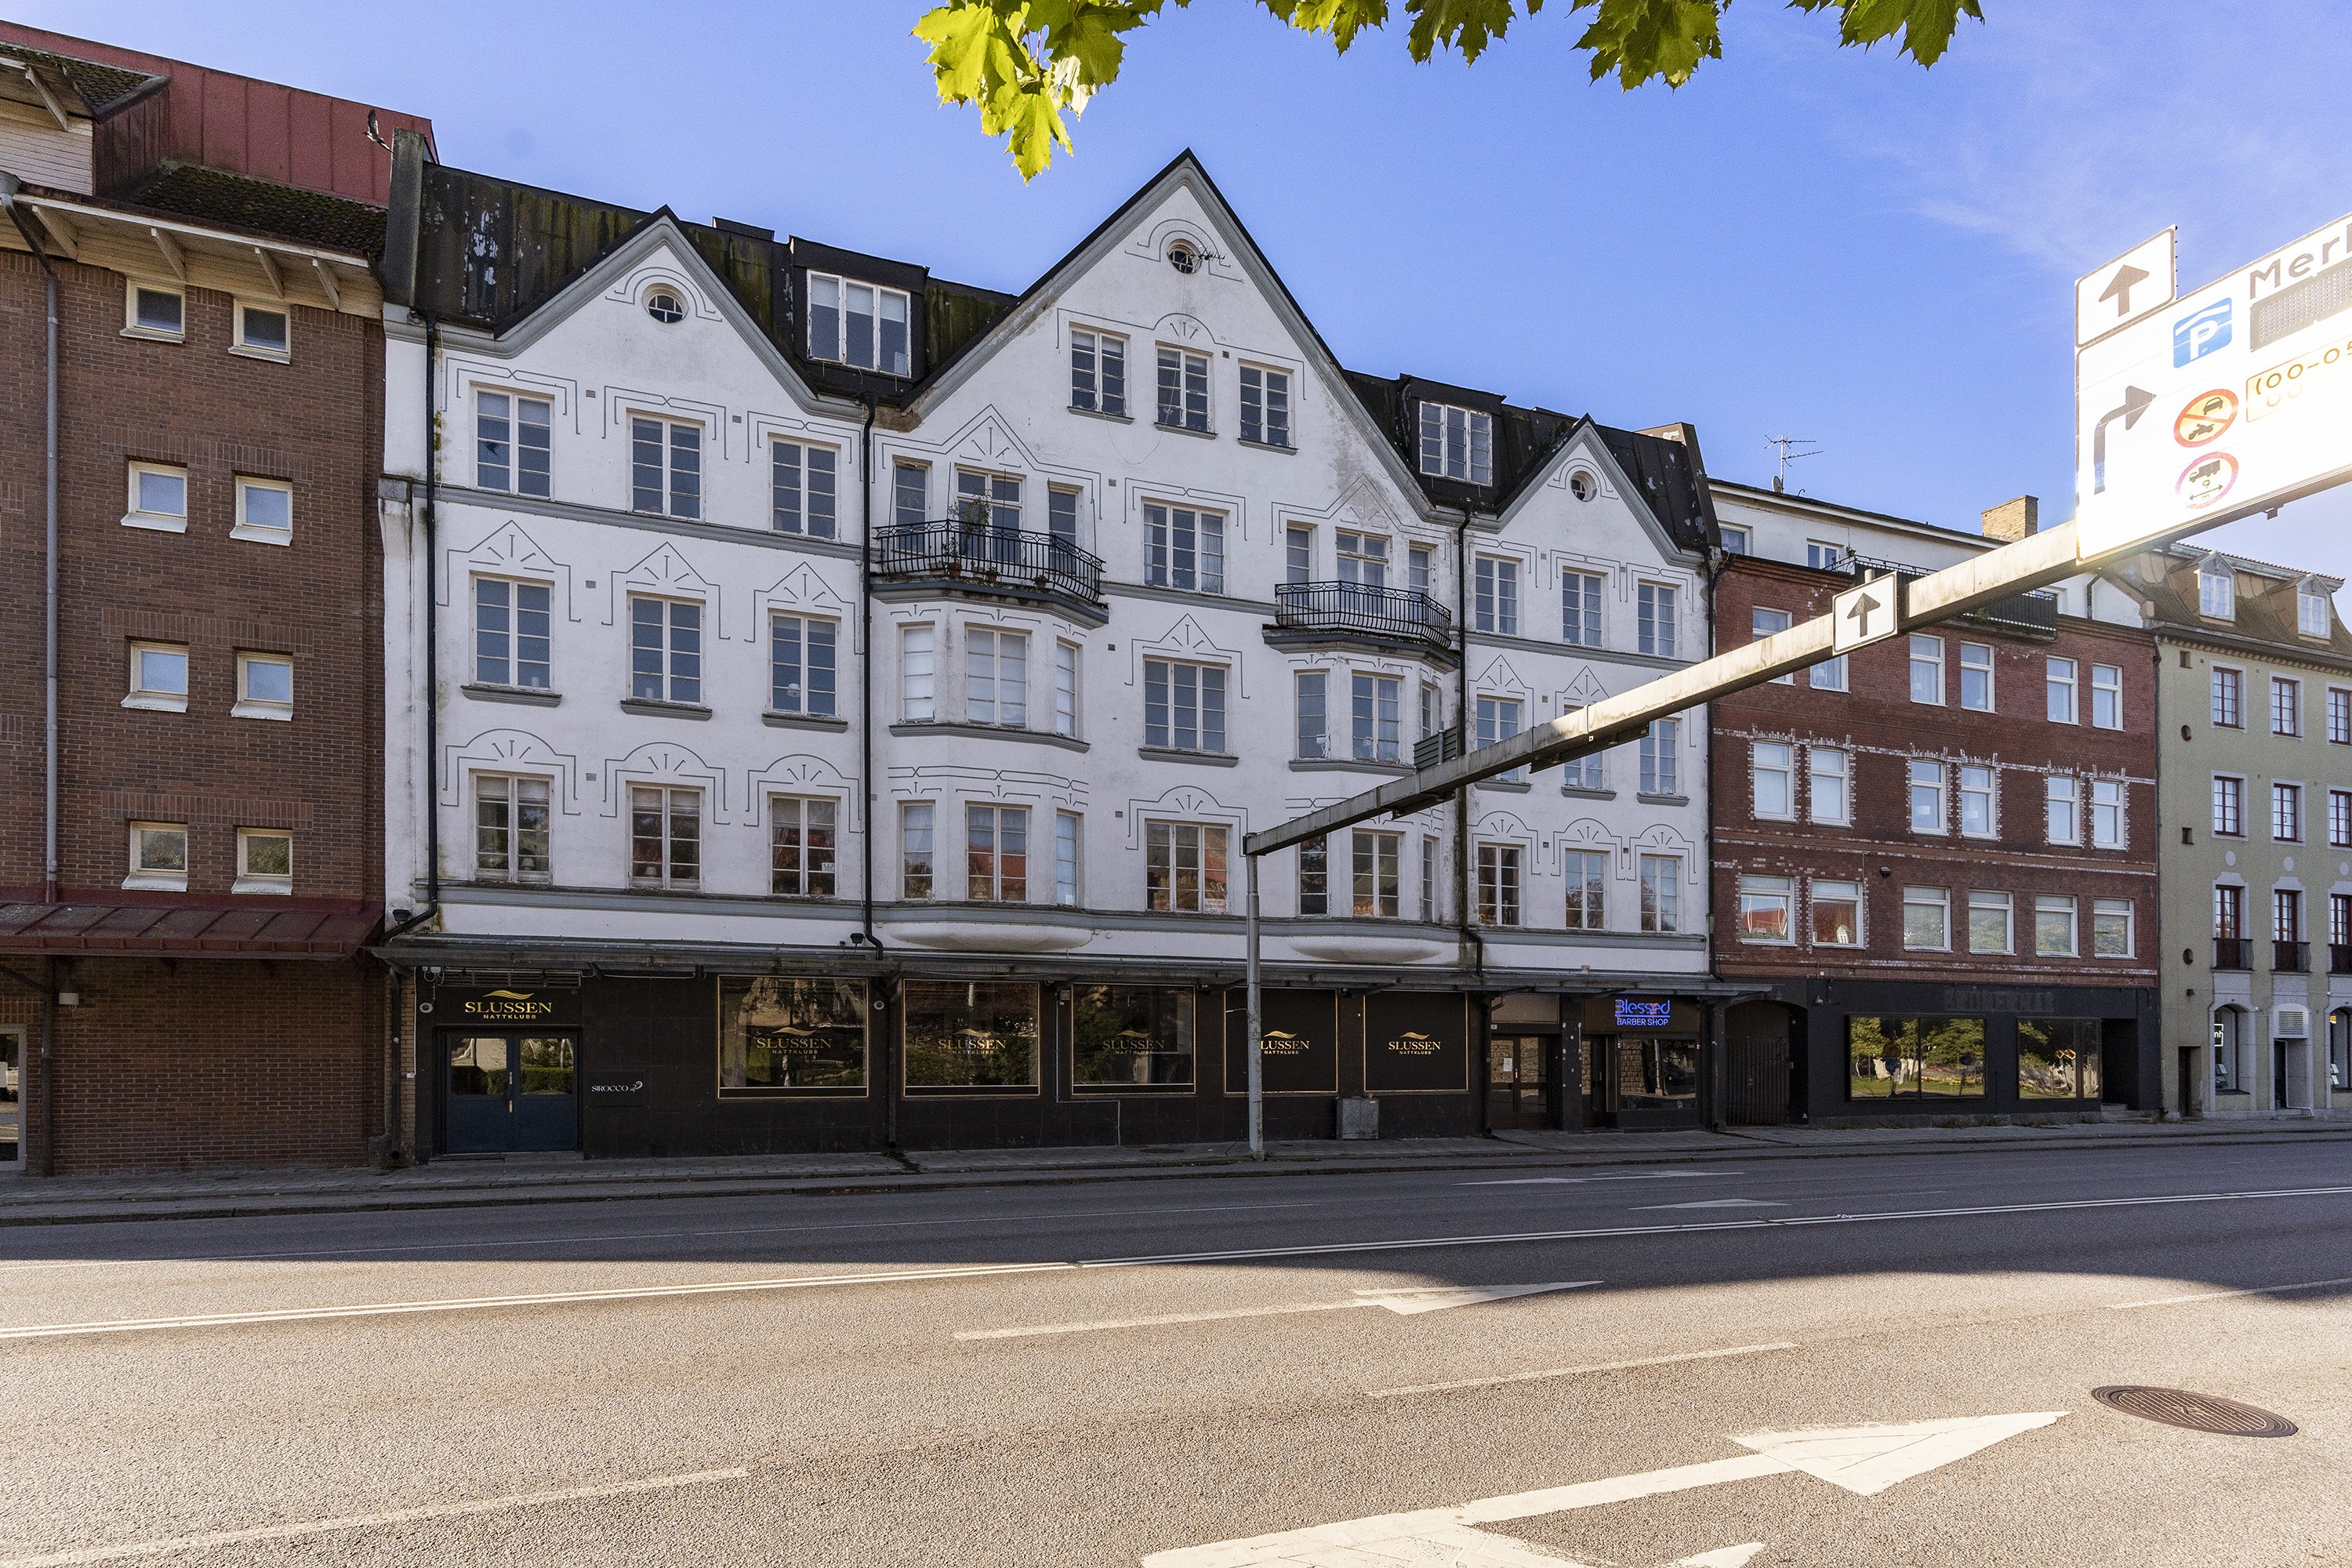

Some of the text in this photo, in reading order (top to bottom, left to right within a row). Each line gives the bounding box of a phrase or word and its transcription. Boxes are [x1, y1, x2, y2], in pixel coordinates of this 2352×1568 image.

[2190, 320, 2217, 361] P
[465, 1002, 552, 1013] SLUSSEN
[1615, 999, 1670, 1014] Blessed
[1617, 1018, 1646, 1026] BARBER
[757, 1038, 832, 1049] SLUSSEN
[938, 1039, 1006, 1049] SLUSSEN
[1102, 1040, 1165, 1050] SLUSSEN
[1260, 1040, 1309, 1050] LUSSEN
[1388, 1041, 1441, 1050] SLUSSEN
